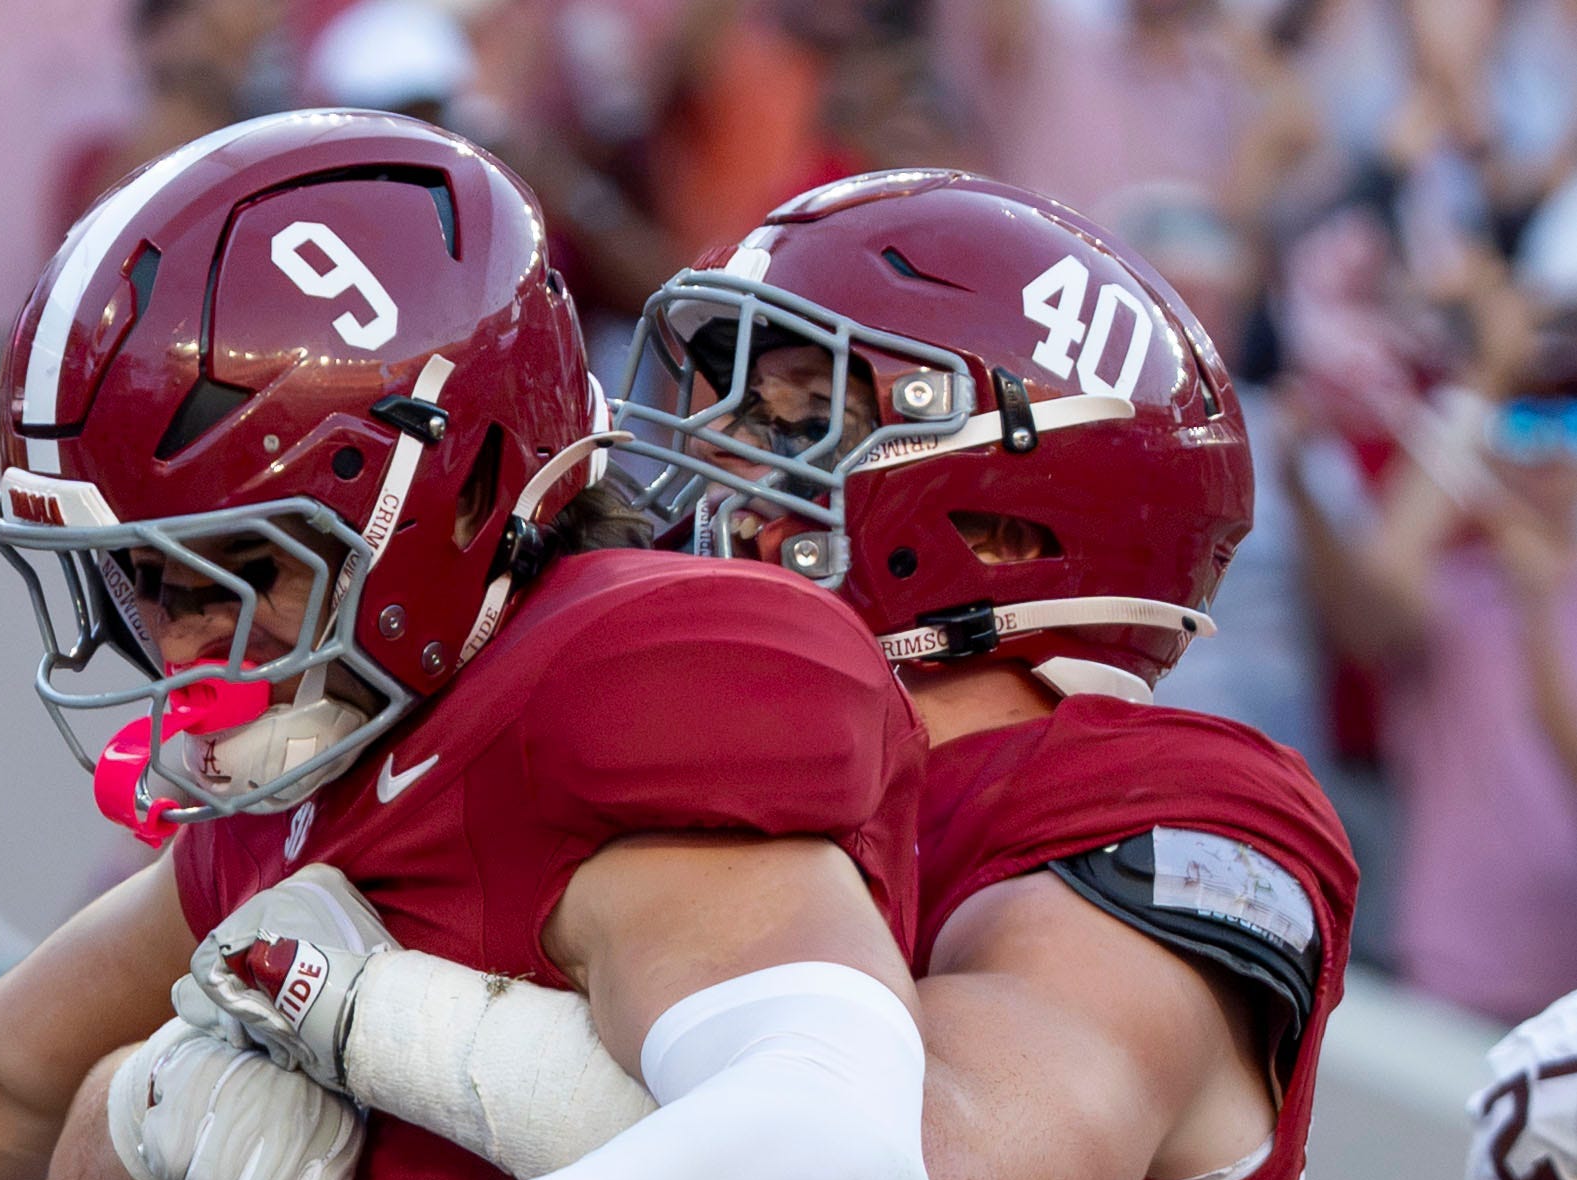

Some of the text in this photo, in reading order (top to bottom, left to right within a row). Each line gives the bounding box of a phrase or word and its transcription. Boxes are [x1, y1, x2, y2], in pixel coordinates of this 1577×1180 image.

[271, 221, 398, 351] 9
[1022, 255, 1153, 401] 40
[364, 493, 400, 551] CRIM
[465, 607, 498, 651] TIDE
[882, 612, 1018, 658] RIMSO DE
[278, 961, 322, 1022] TIDE
